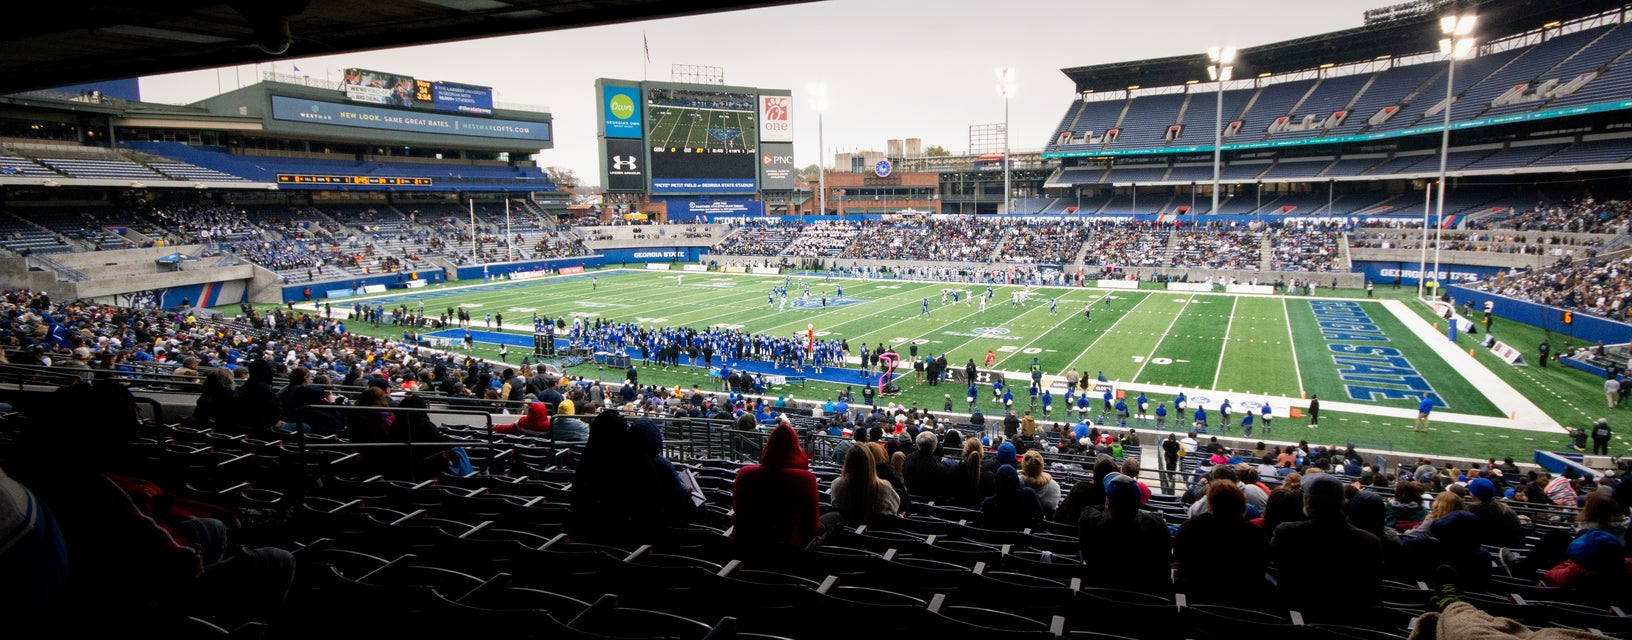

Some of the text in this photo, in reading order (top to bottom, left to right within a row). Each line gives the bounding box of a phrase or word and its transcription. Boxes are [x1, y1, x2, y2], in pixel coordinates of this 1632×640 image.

[611, 102, 632, 111] Own
[766, 123, 788, 131] one
[1308, 300, 1391, 343] GEORGIA
[1565, 312, 1572, 324] 6
[997, 345, 1043, 354] 20
[1132, 355, 1172, 364] 10
[1327, 345, 1450, 410] STATE
